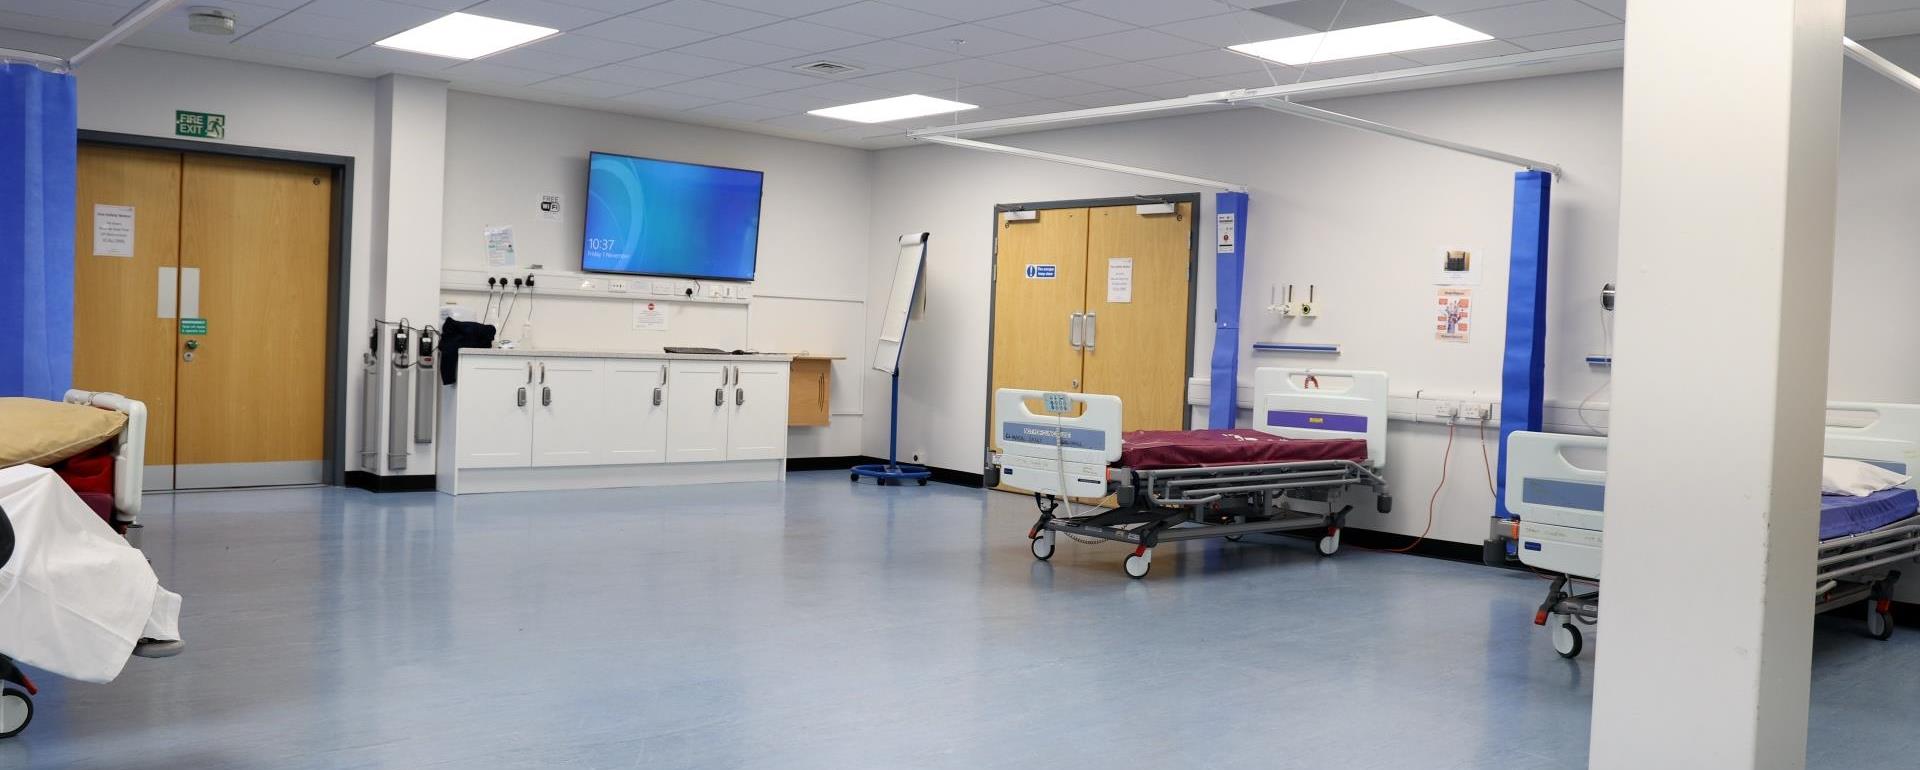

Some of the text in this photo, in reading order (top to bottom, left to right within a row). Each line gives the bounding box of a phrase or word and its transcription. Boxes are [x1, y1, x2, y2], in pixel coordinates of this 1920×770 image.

[180, 113, 204, 125] FIRE
[180, 123, 203, 135] EXIT
[542, 195, 560, 203] FREE
[589, 238, 615, 251] 10:37
